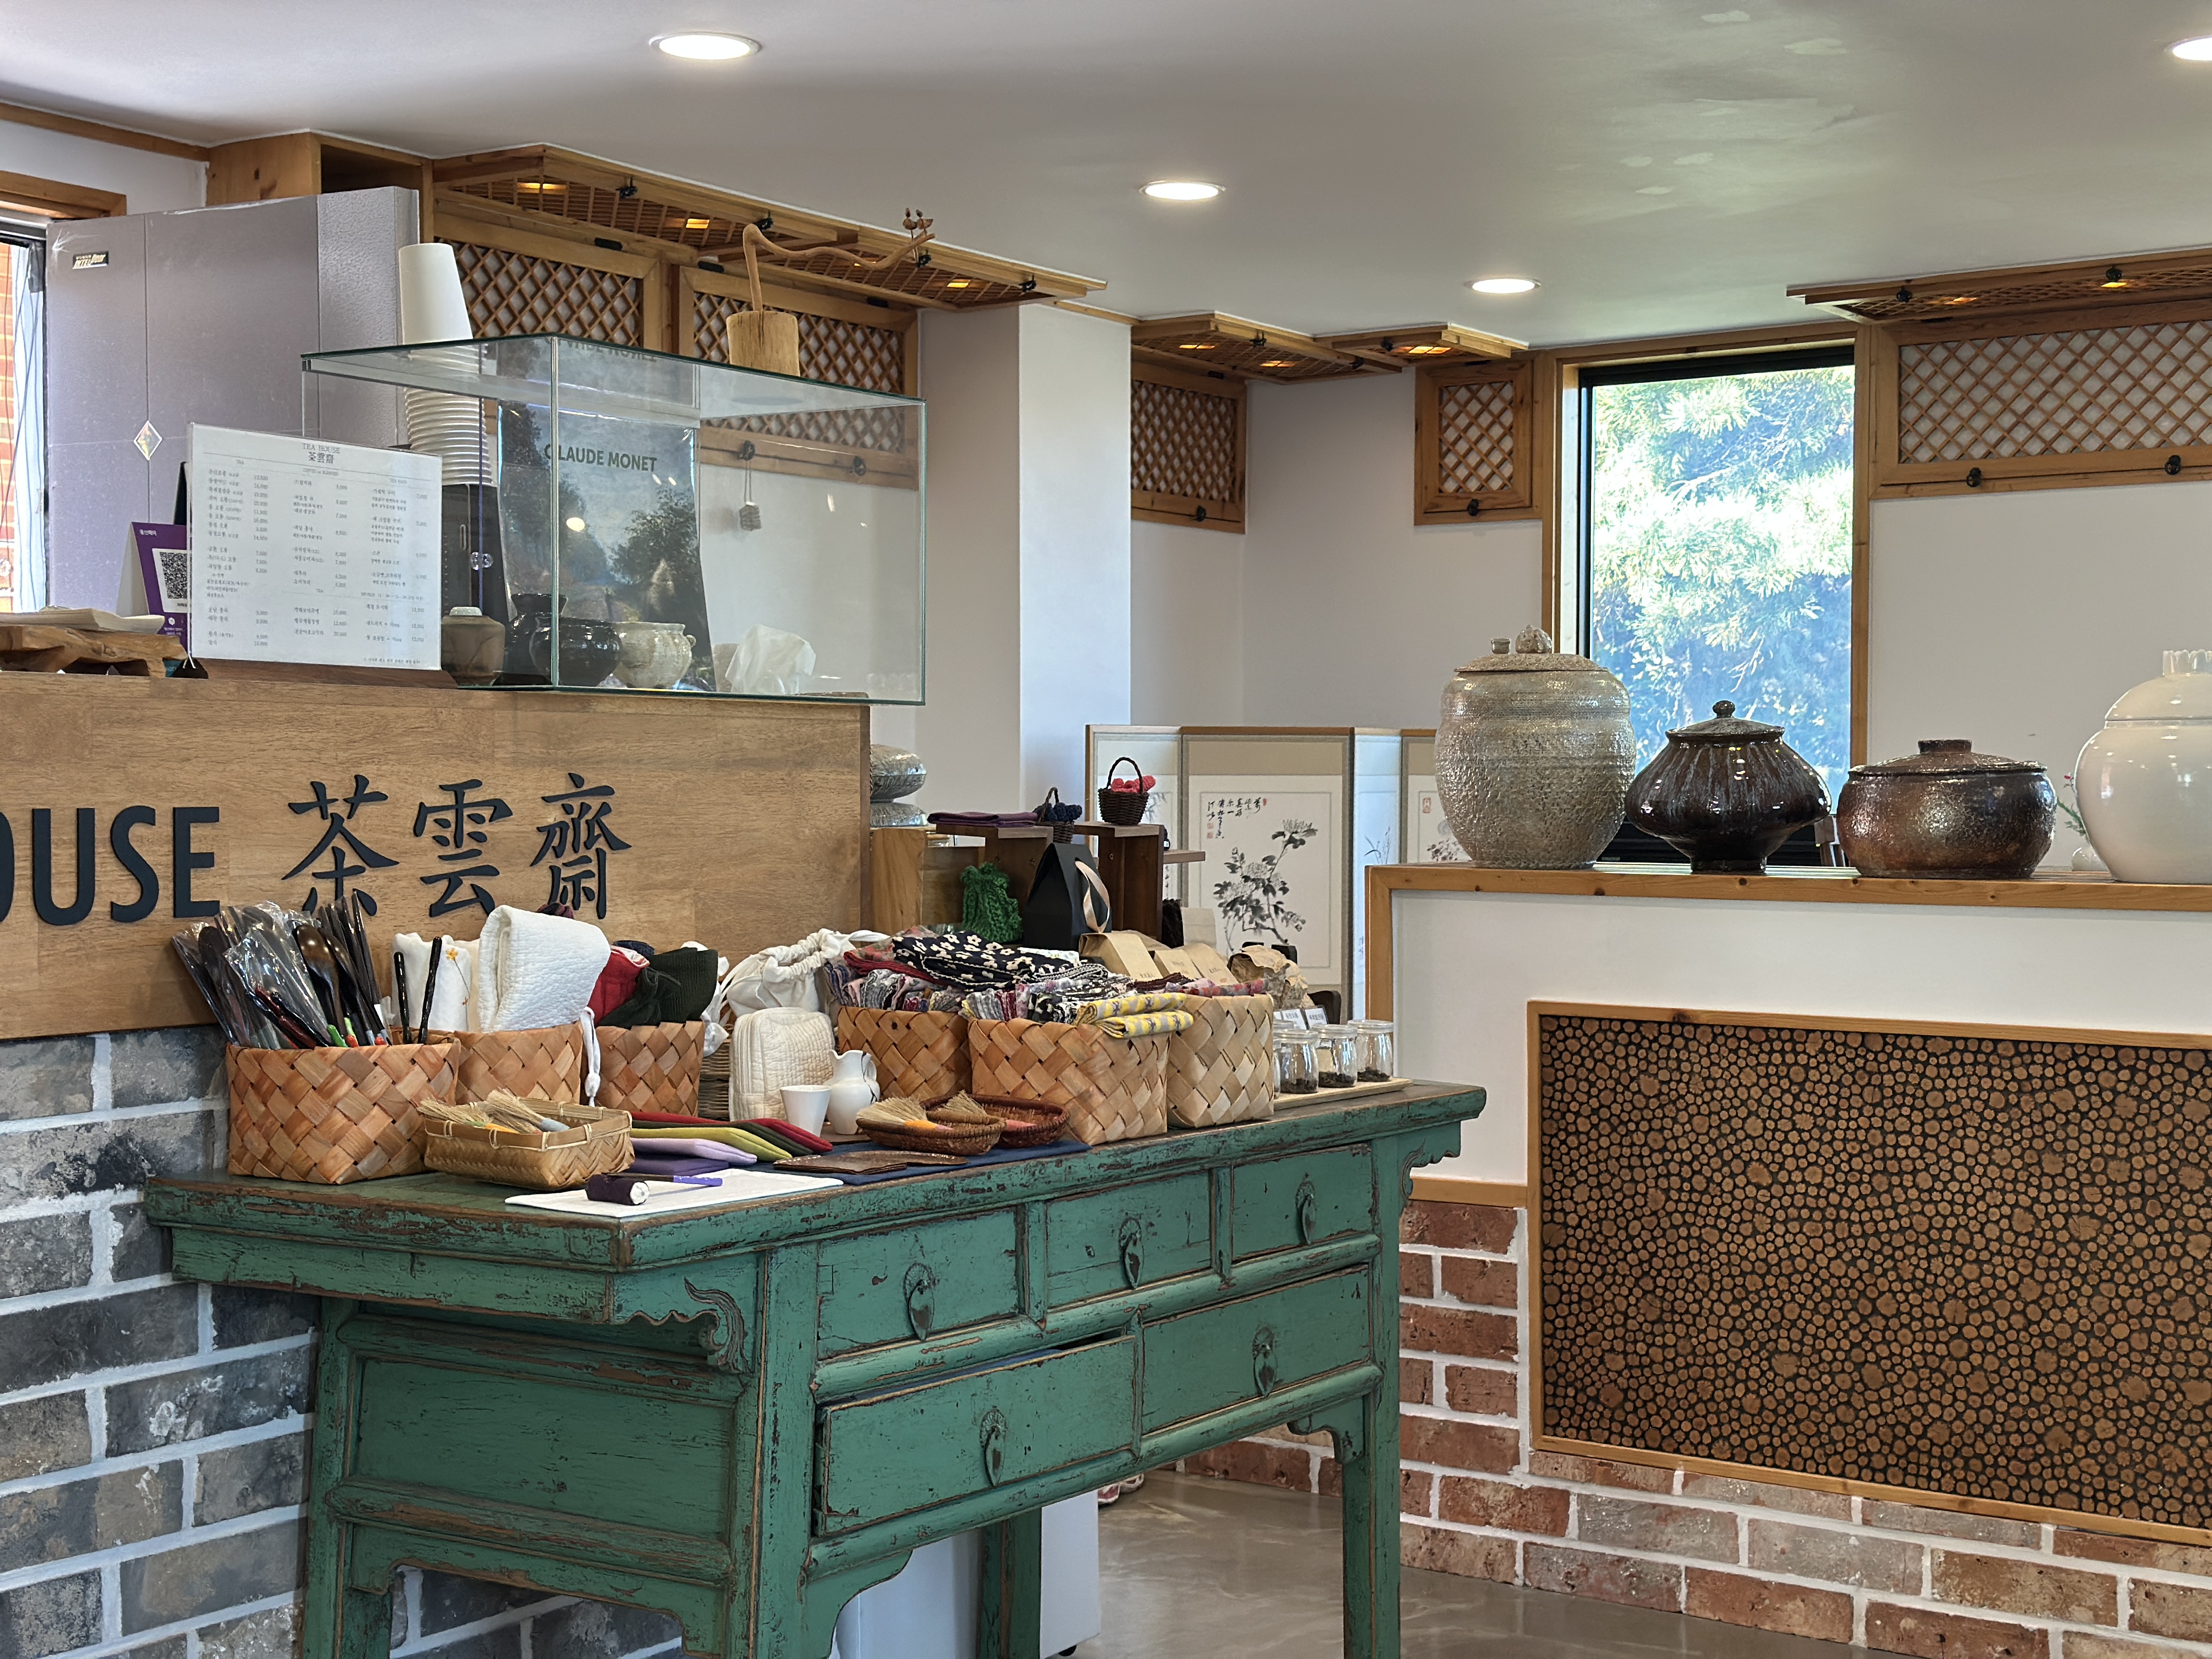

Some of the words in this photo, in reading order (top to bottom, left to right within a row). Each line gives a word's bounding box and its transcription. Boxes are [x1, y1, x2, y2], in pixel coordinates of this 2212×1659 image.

[319, 445, 340, 454] HOUSE
[607, 451, 657, 472] MONET
[0, 805, 220, 926] USE
[281, 772, 633, 920] 茶雲齋
